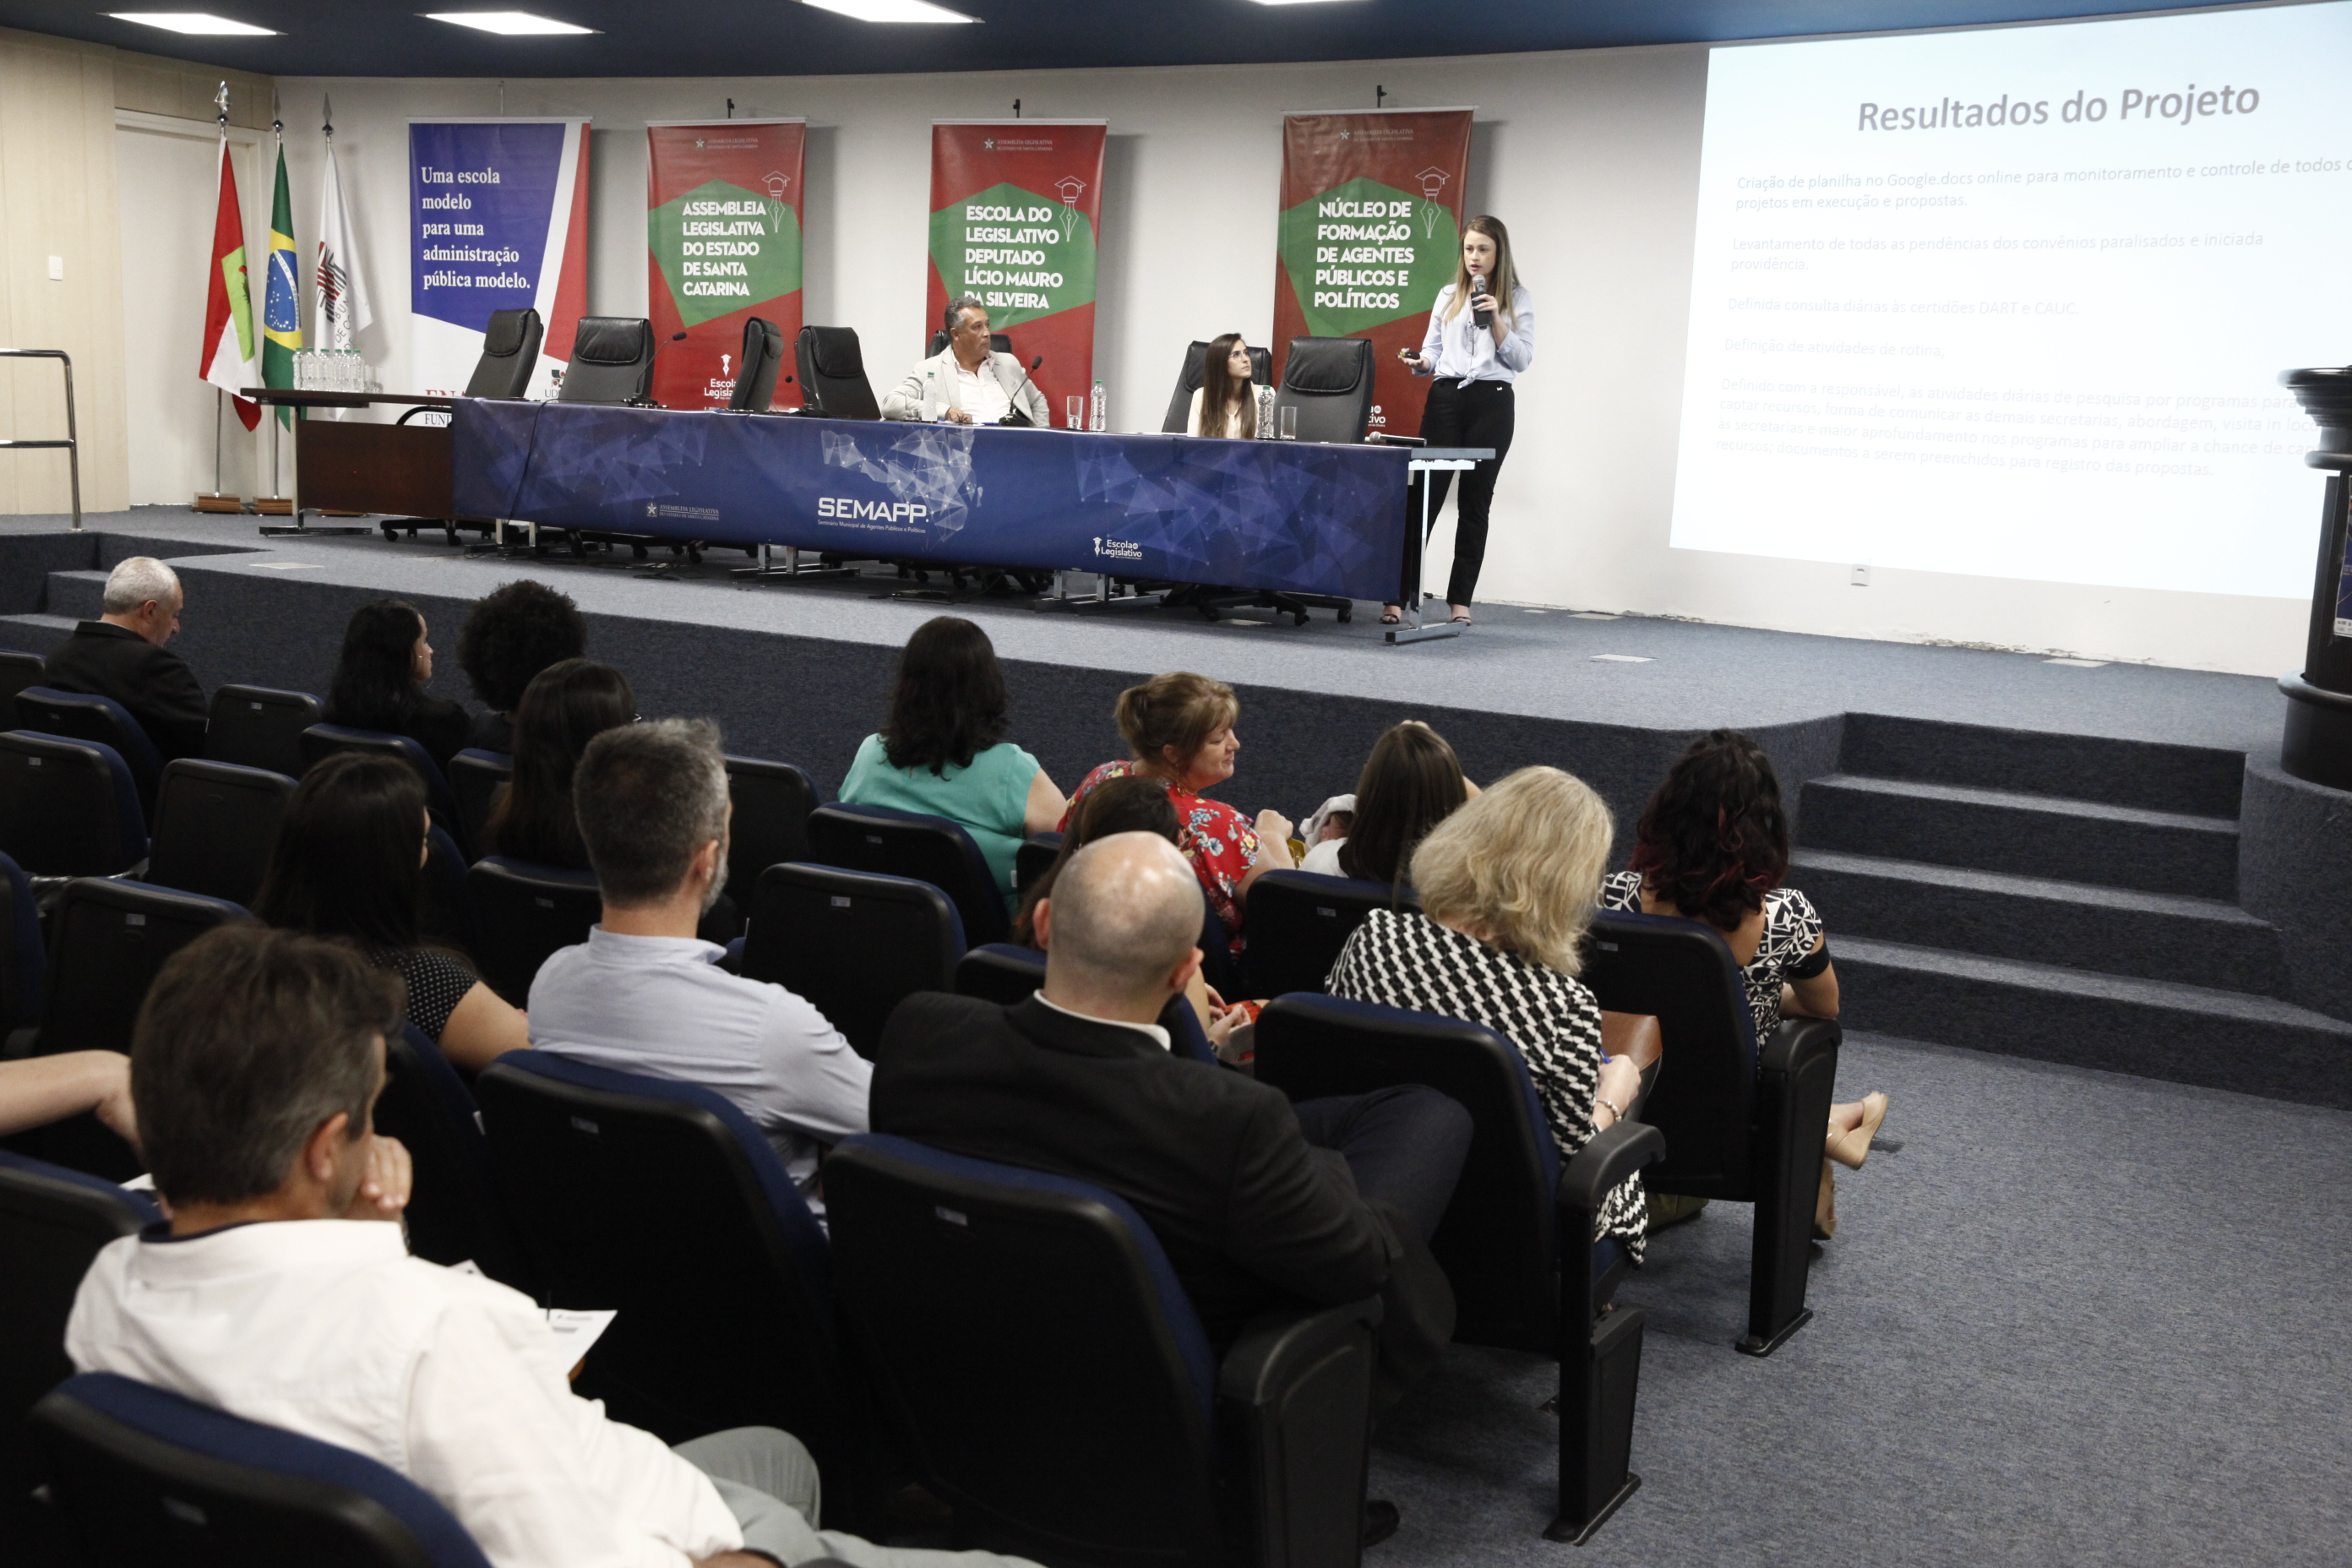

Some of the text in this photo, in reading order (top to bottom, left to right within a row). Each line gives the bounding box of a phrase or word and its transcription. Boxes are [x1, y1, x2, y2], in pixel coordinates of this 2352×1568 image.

[1859, 84, 2260, 131] Resultados do Projeto
[421, 167, 500, 185] Uma escola
[1738, 175, 1784, 192] Criação
[1788, 174, 1805, 188] de
[1809, 173, 1861, 190] planilha
[1866, 177, 1883, 186] no
[1887, 171, 1973, 189] Google.docs
[1977, 169, 2022, 184] online
[2027, 172, 2059, 186] para
[2064, 166, 2182, 181] monitoramento
[2186, 166, 2196, 177] e
[2201, 159, 2266, 177] controle
[2270, 158, 2290, 174] de
[2295, 155, 2341, 173] todos
[422, 193, 471, 210] modelo
[683, 201, 766, 216] ASSEMBLEIA
[1318, 197, 1412, 218] NÚCLEO DE
[1736, 193, 1968, 212] projetos em execução e propostas.
[966, 206, 1053, 222] ESCOLA DO
[422, 222, 484, 239] para uma
[683, 220, 765, 237] LEGISLATIVA
[966, 227, 1059, 244] LEGISLATIVO
[1317, 220, 1411, 245] FORMAÇÃO
[683, 242, 760, 256] DO ESTADO
[1733, 230, 2263, 253] Levantamento de todas as pendências dos convênios paralisados e iniciada
[422, 246, 520, 267] administração
[965, 248, 1046, 265] DEPUTADO
[1316, 247, 1414, 264] DE AGENTES
[1731, 256, 1809, 272] providência.
[683, 262, 748, 276] DE SANTA
[964, 266, 1064, 288] LÍCIO MAURO
[1315, 265, 1408, 286] PÚBLICOS E
[423, 271, 531, 291] pública modelo.
[683, 282, 750, 297] CATARINA
[986, 291, 1049, 309] SILVEIRA
[1314, 288, 1400, 308] POLÍTICOS
[1729, 297, 2078, 315] Definida consulta diárias às certidões DART e CAUC.
[1725, 337, 1946, 359] Definição de atividades de rotina;
[1717, 440, 2213, 477] recursos; documentos a serem preenchidos para registro das propostas.
[1101, 547, 1142, 558] Legislativo
[1107, 539, 1133, 549] Escola
